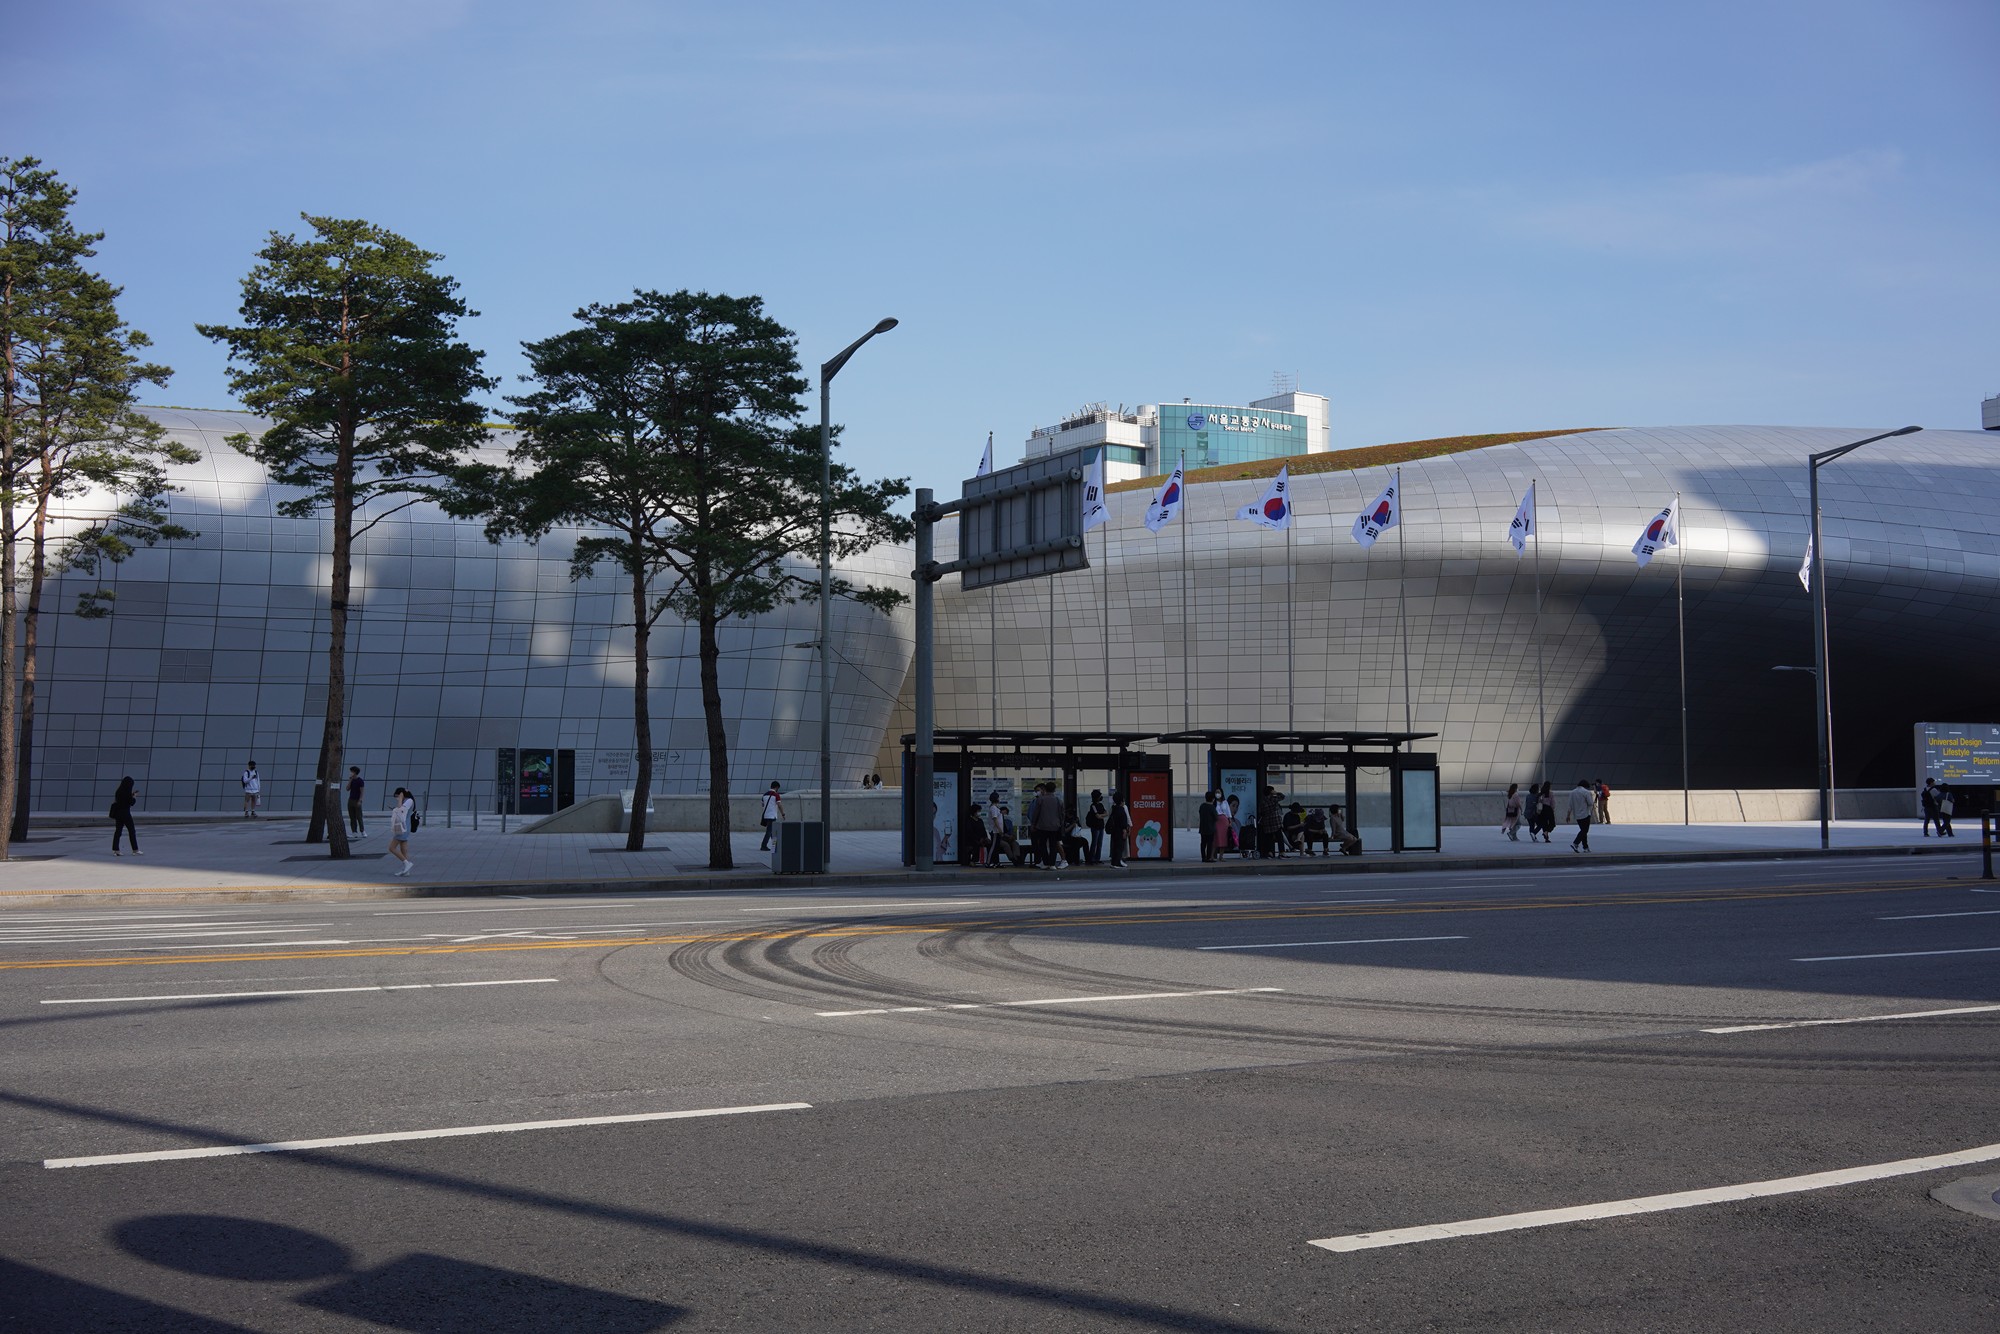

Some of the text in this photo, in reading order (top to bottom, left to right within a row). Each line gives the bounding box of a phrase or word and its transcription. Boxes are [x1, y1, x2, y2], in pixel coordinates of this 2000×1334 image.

[1208, 413, 1269, 428] 서울교통공사
[1928, 738, 1982, 747] Universal Design
[1943, 748, 1970, 757] Lifestyle
[1973, 757, 2000, 765] Platform
[1133, 801, 1165, 809] 당근이세요?
